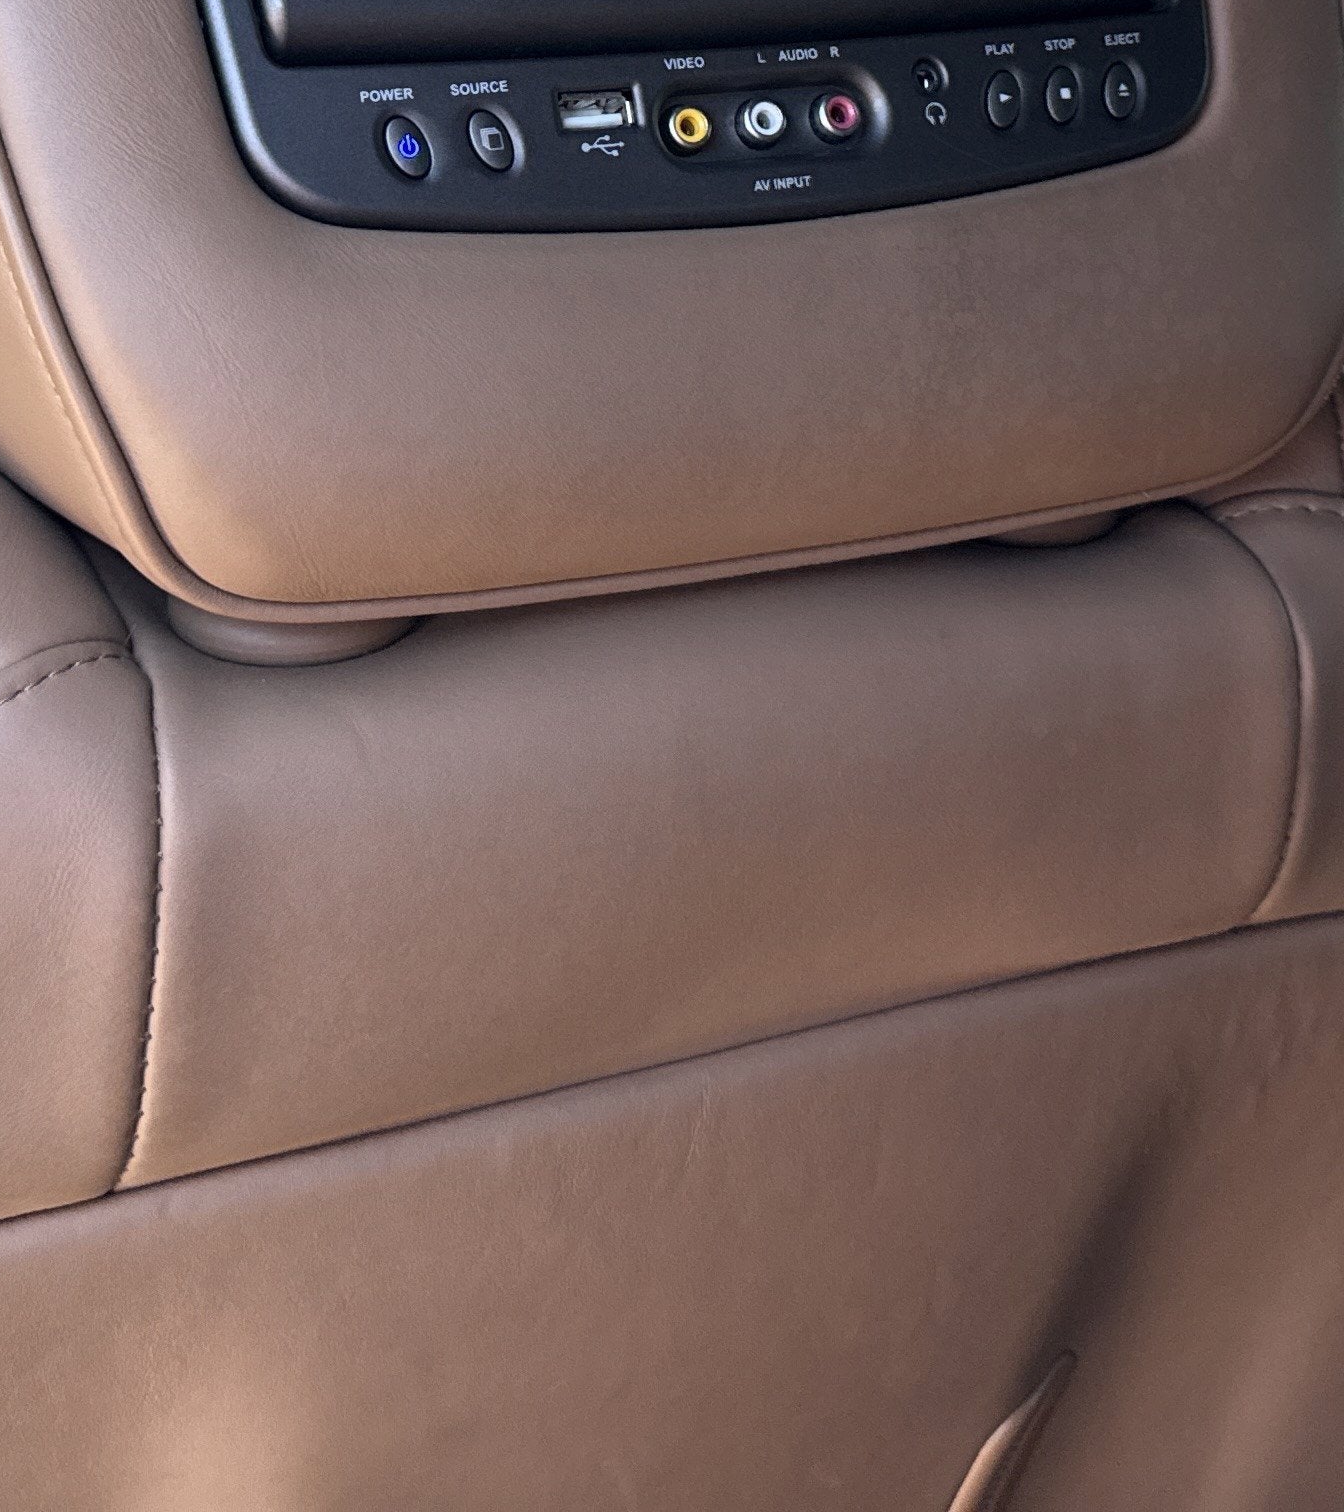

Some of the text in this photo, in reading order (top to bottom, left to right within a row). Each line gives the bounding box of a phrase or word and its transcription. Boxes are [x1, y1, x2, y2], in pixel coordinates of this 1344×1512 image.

[1042, 37, 1076, 52] STOP
[1103, 31, 1142, 48] EJECT
[756, 45, 841, 65] L AUDIO R
[984, 42, 1016, 57] PLAY
[663, 56, 706, 71] VIDEO
[358, 86, 415, 104] POWER
[449, 79, 510, 98] SOURCE
[753, 175, 812, 192] AV INPUT
